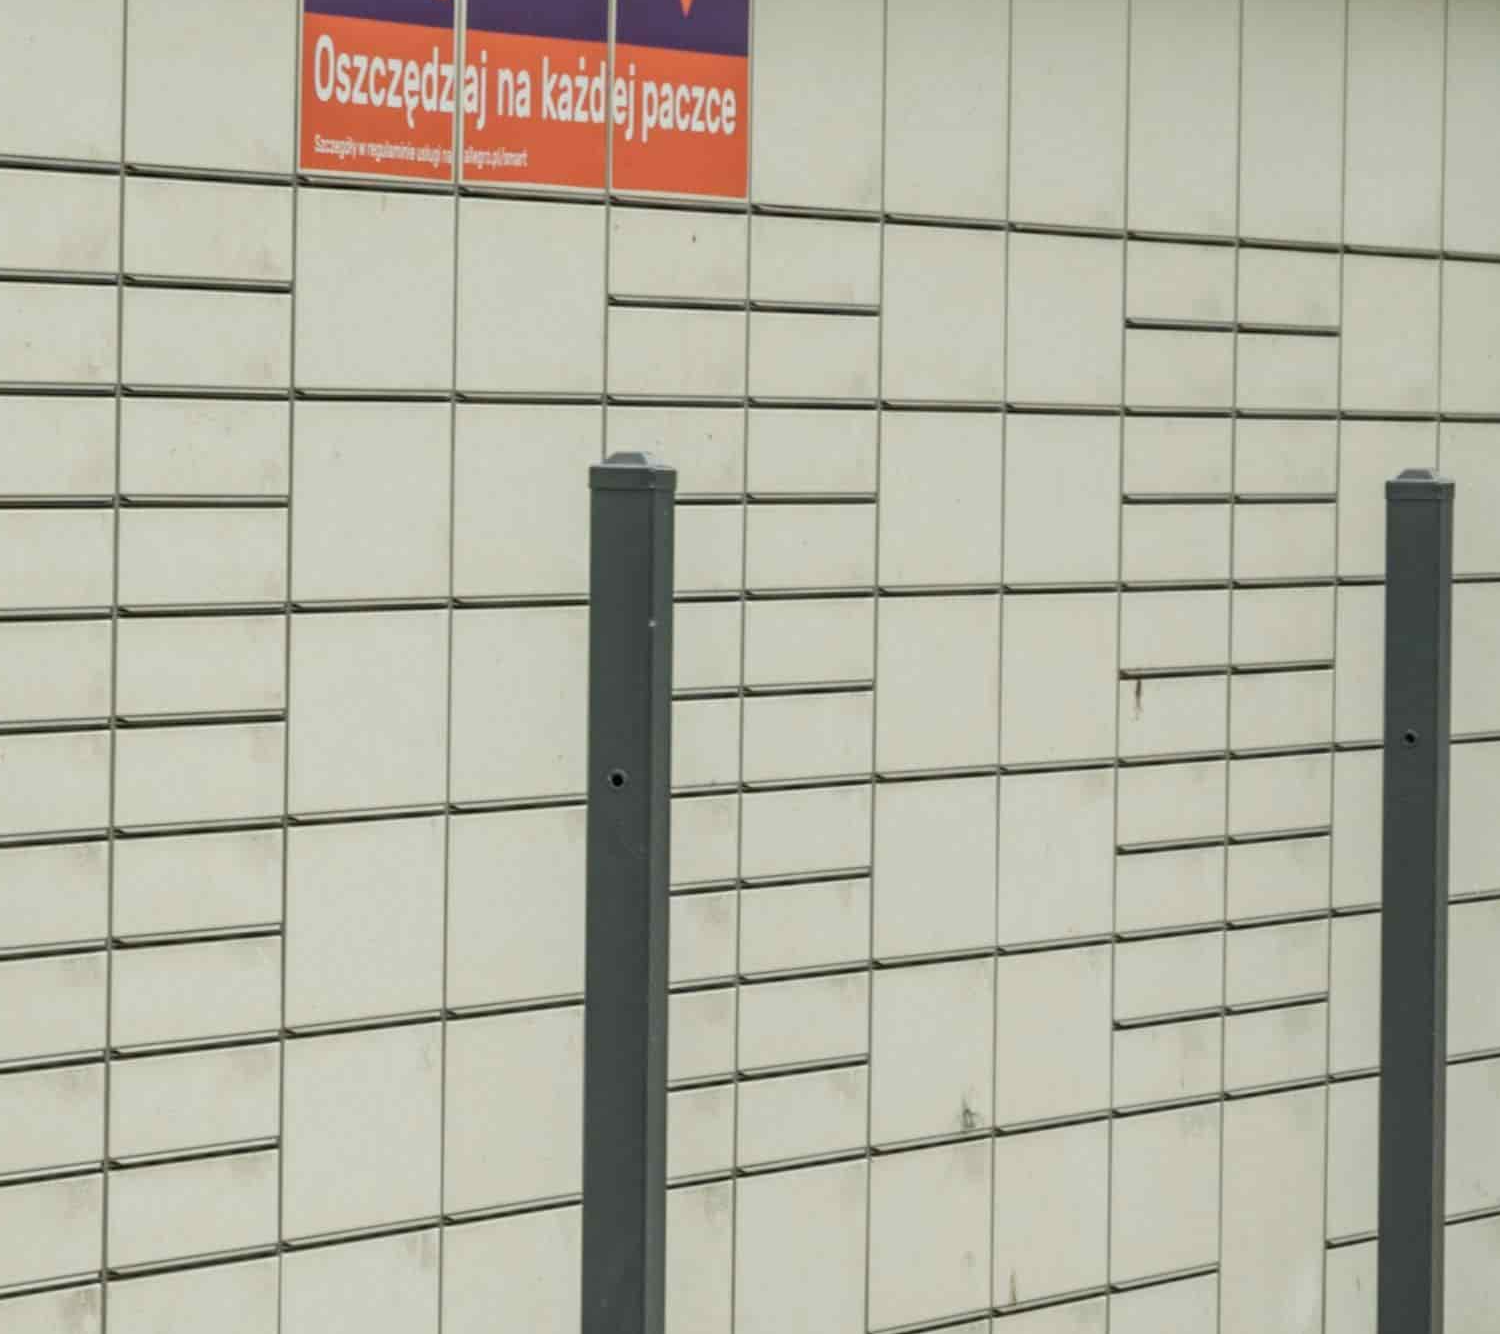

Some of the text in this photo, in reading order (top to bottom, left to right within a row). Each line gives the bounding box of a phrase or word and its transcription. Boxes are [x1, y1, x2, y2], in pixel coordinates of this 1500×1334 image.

[313, 34, 737, 143] Oszczędzaj na każdej paczce
